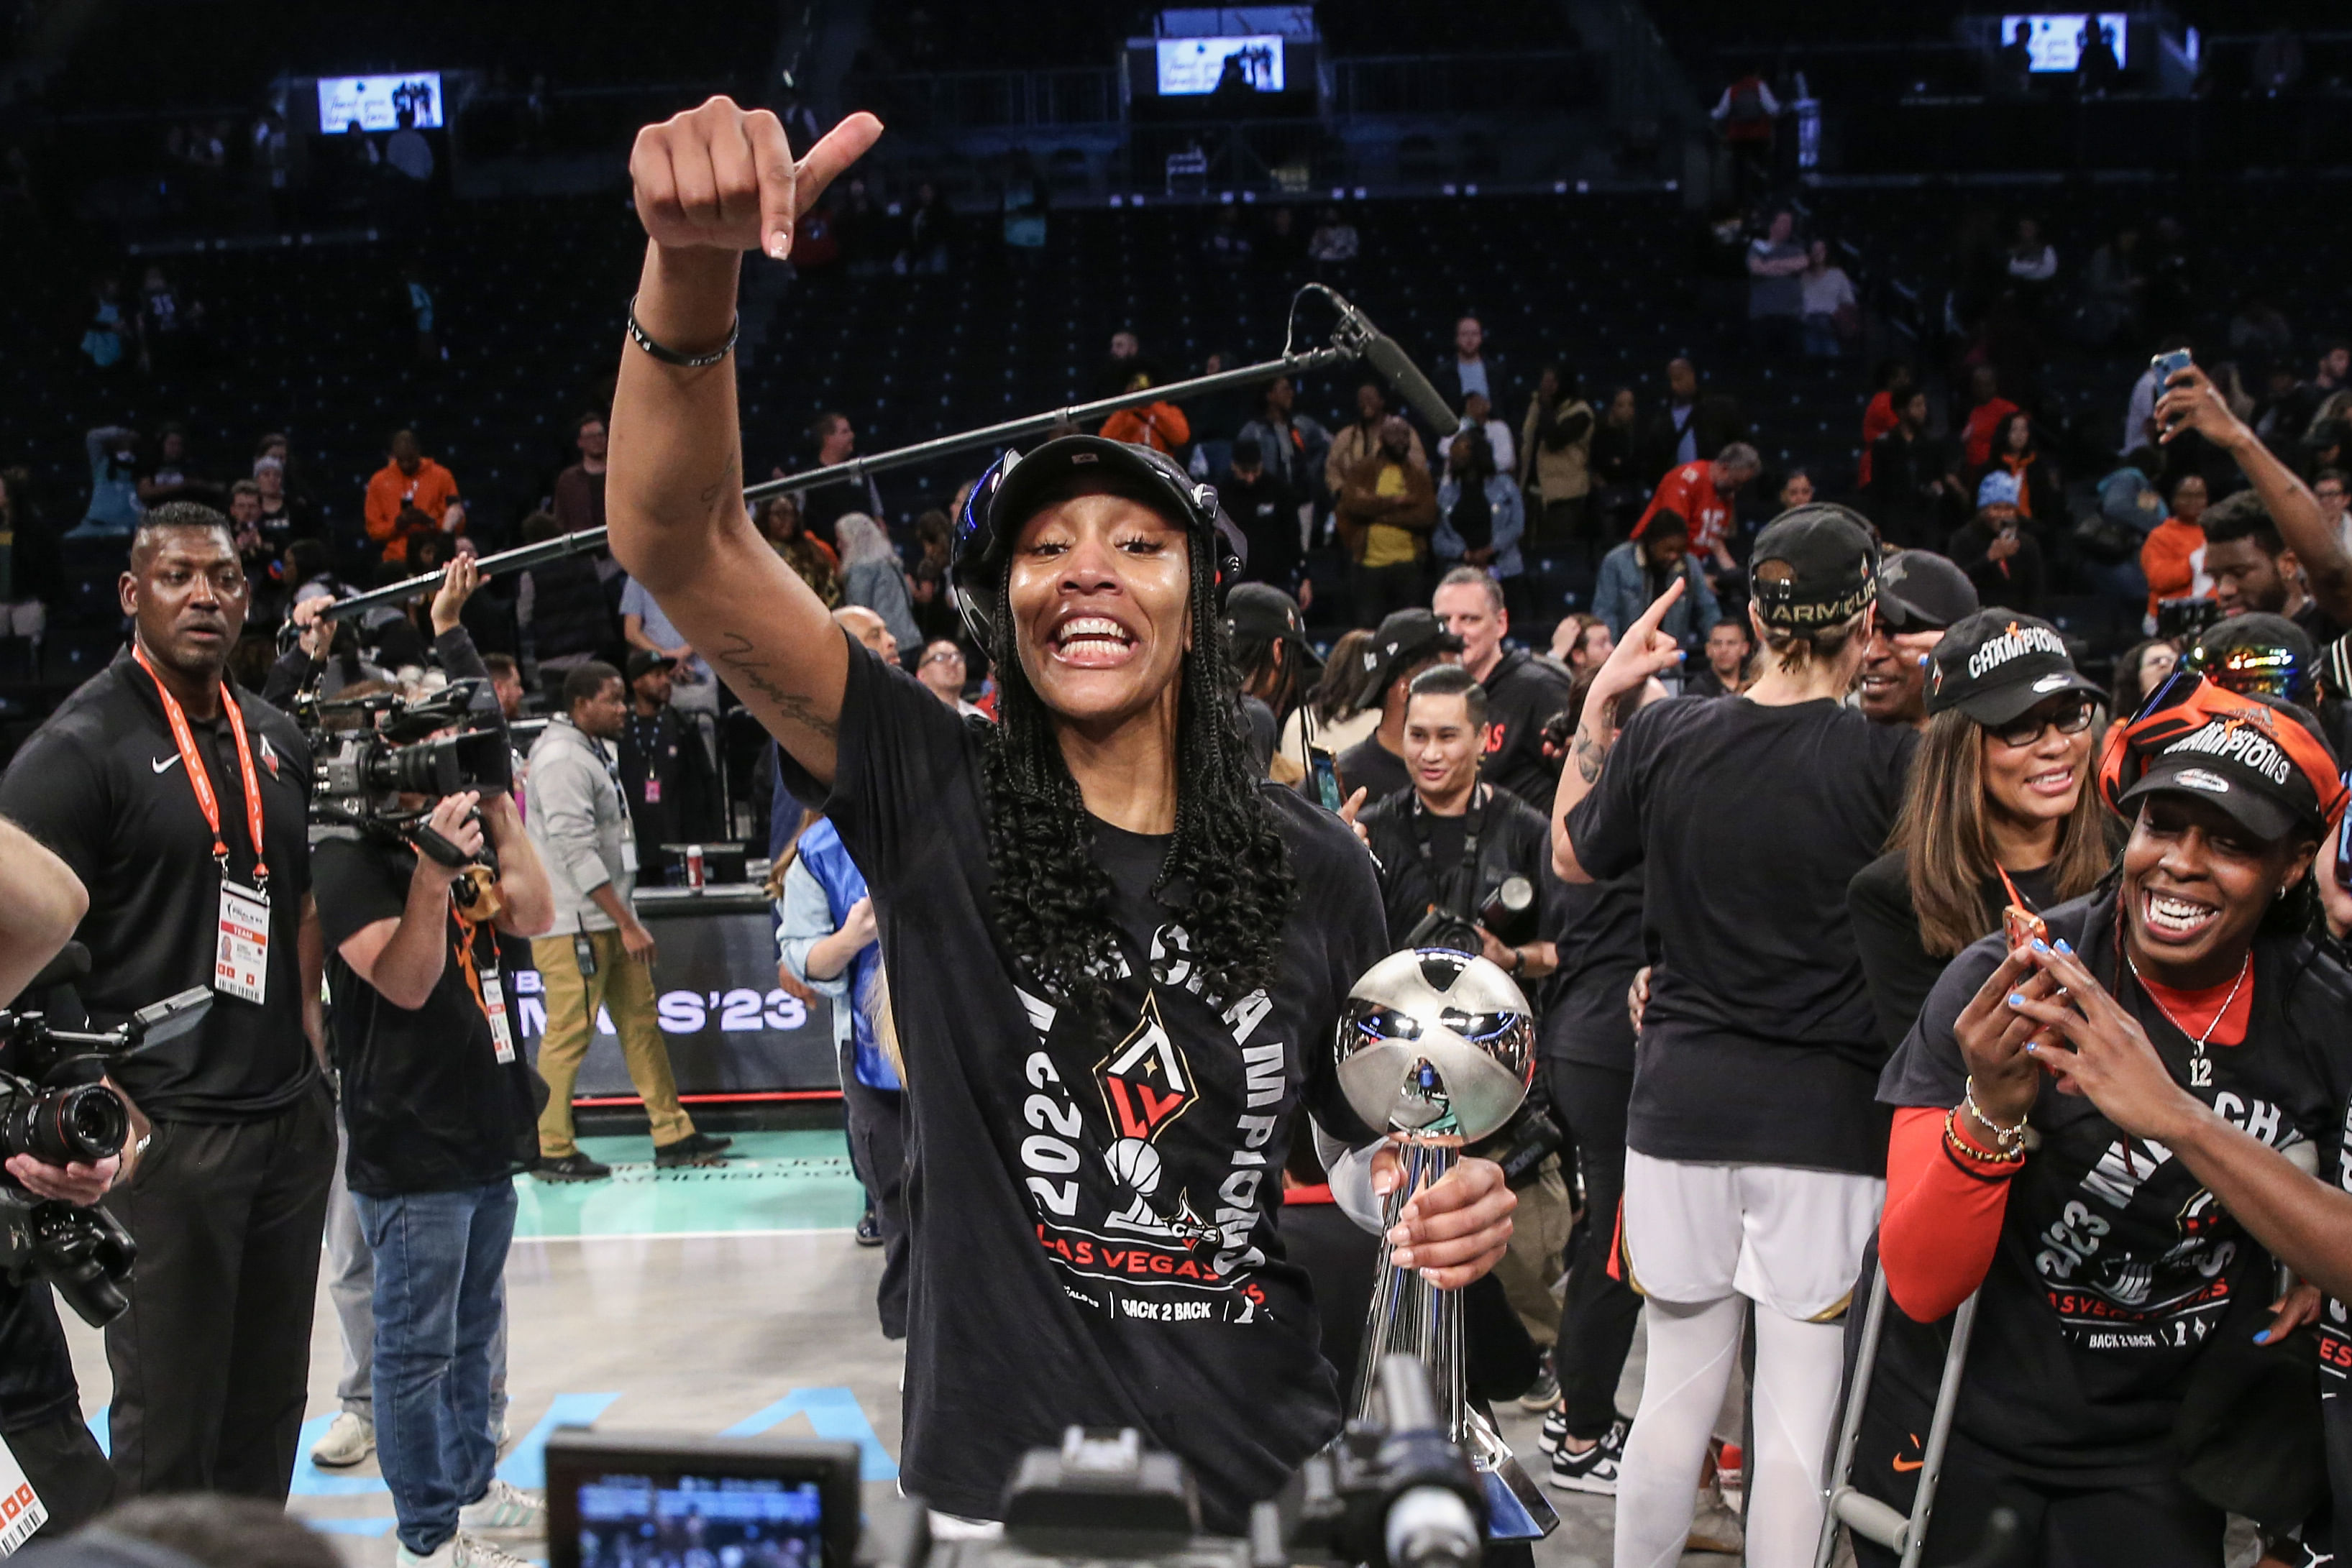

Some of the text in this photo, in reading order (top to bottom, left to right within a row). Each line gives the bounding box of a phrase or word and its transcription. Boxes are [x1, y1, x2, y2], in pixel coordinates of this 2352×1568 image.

[234, 926, 254, 940] TEAM
[2189, 1058, 2213, 1087] 12
[1035, 1223, 1094, 1265] LAS
[1122, 1299, 1212, 1321] BACK 2 BACK
[2088, 1334, 2156, 1349] BACK 2 BACK
